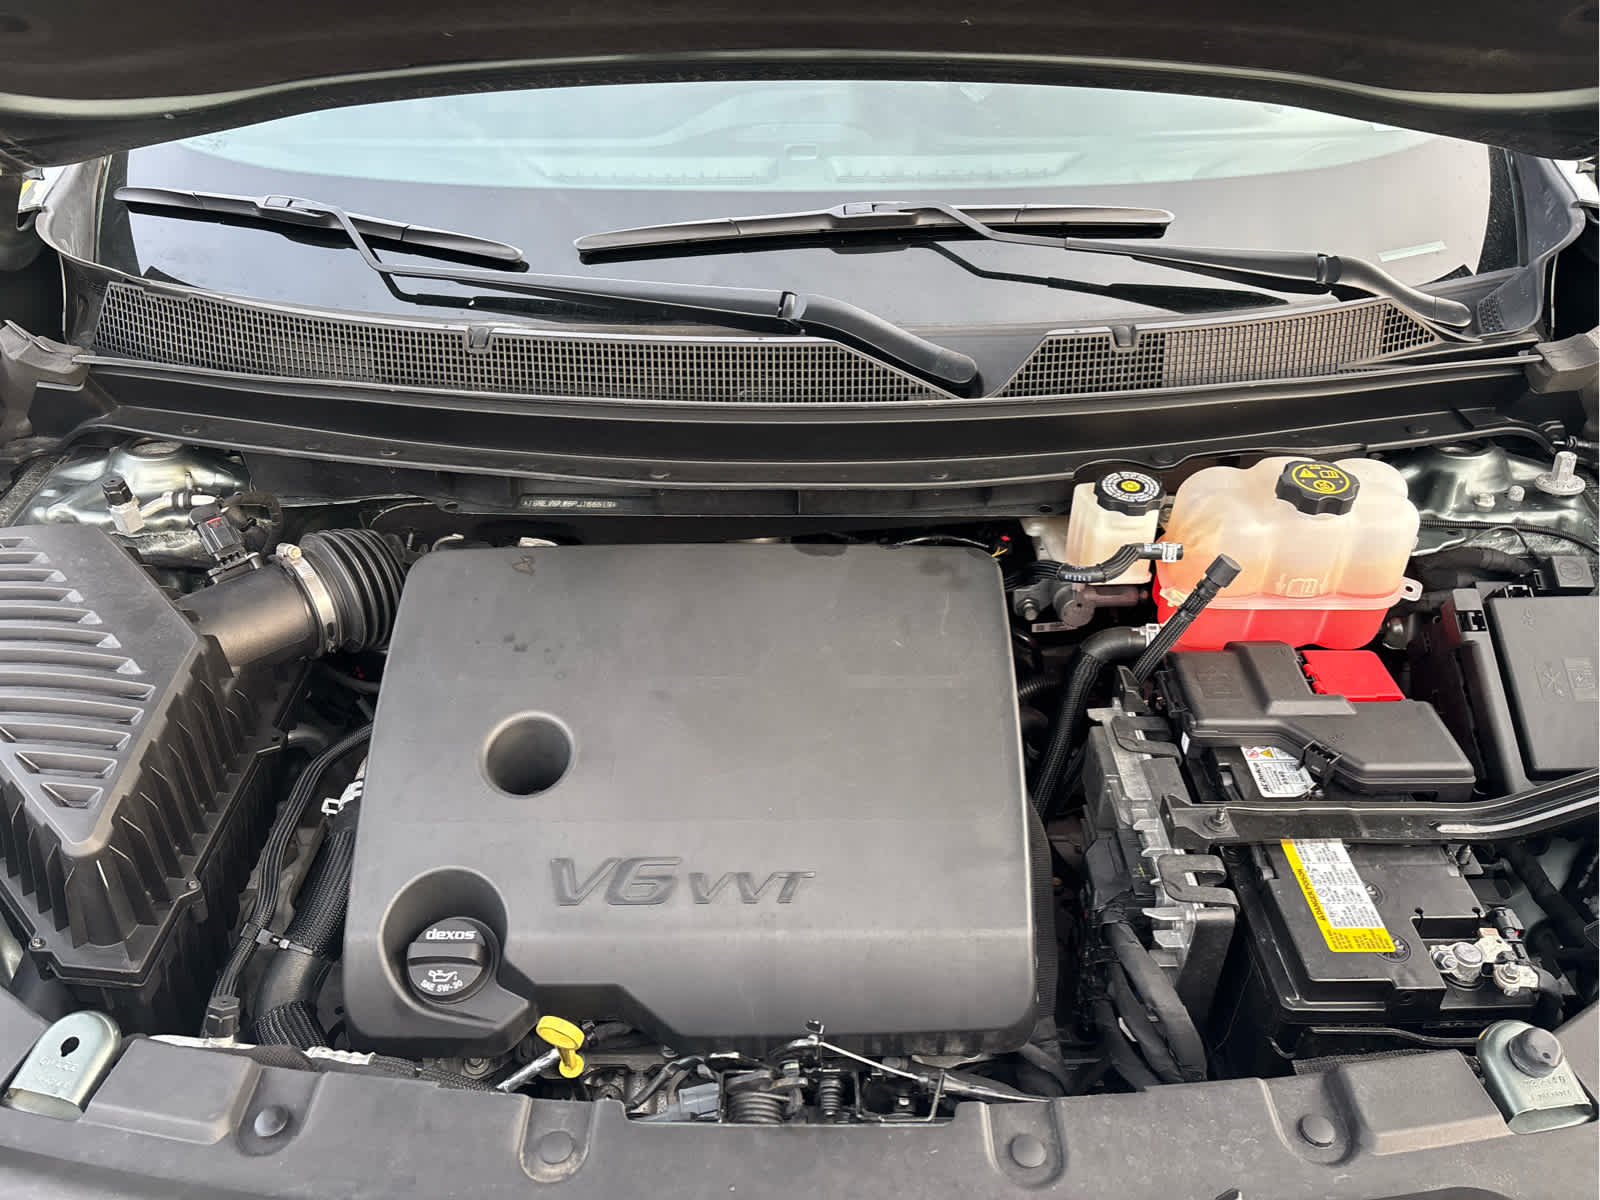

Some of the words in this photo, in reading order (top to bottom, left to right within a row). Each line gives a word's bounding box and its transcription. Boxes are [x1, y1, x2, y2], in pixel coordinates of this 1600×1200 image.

[550, 857, 682, 906] V6
[688, 871, 816, 904] VVT
[1296, 868, 1312, 890] POISON
[1306, 891, 1324, 916] DANGER
[426, 928, 477, 940] dexos
[420, 979, 436, 991] SAE
[436, 979, 463, 992] 5W-30
